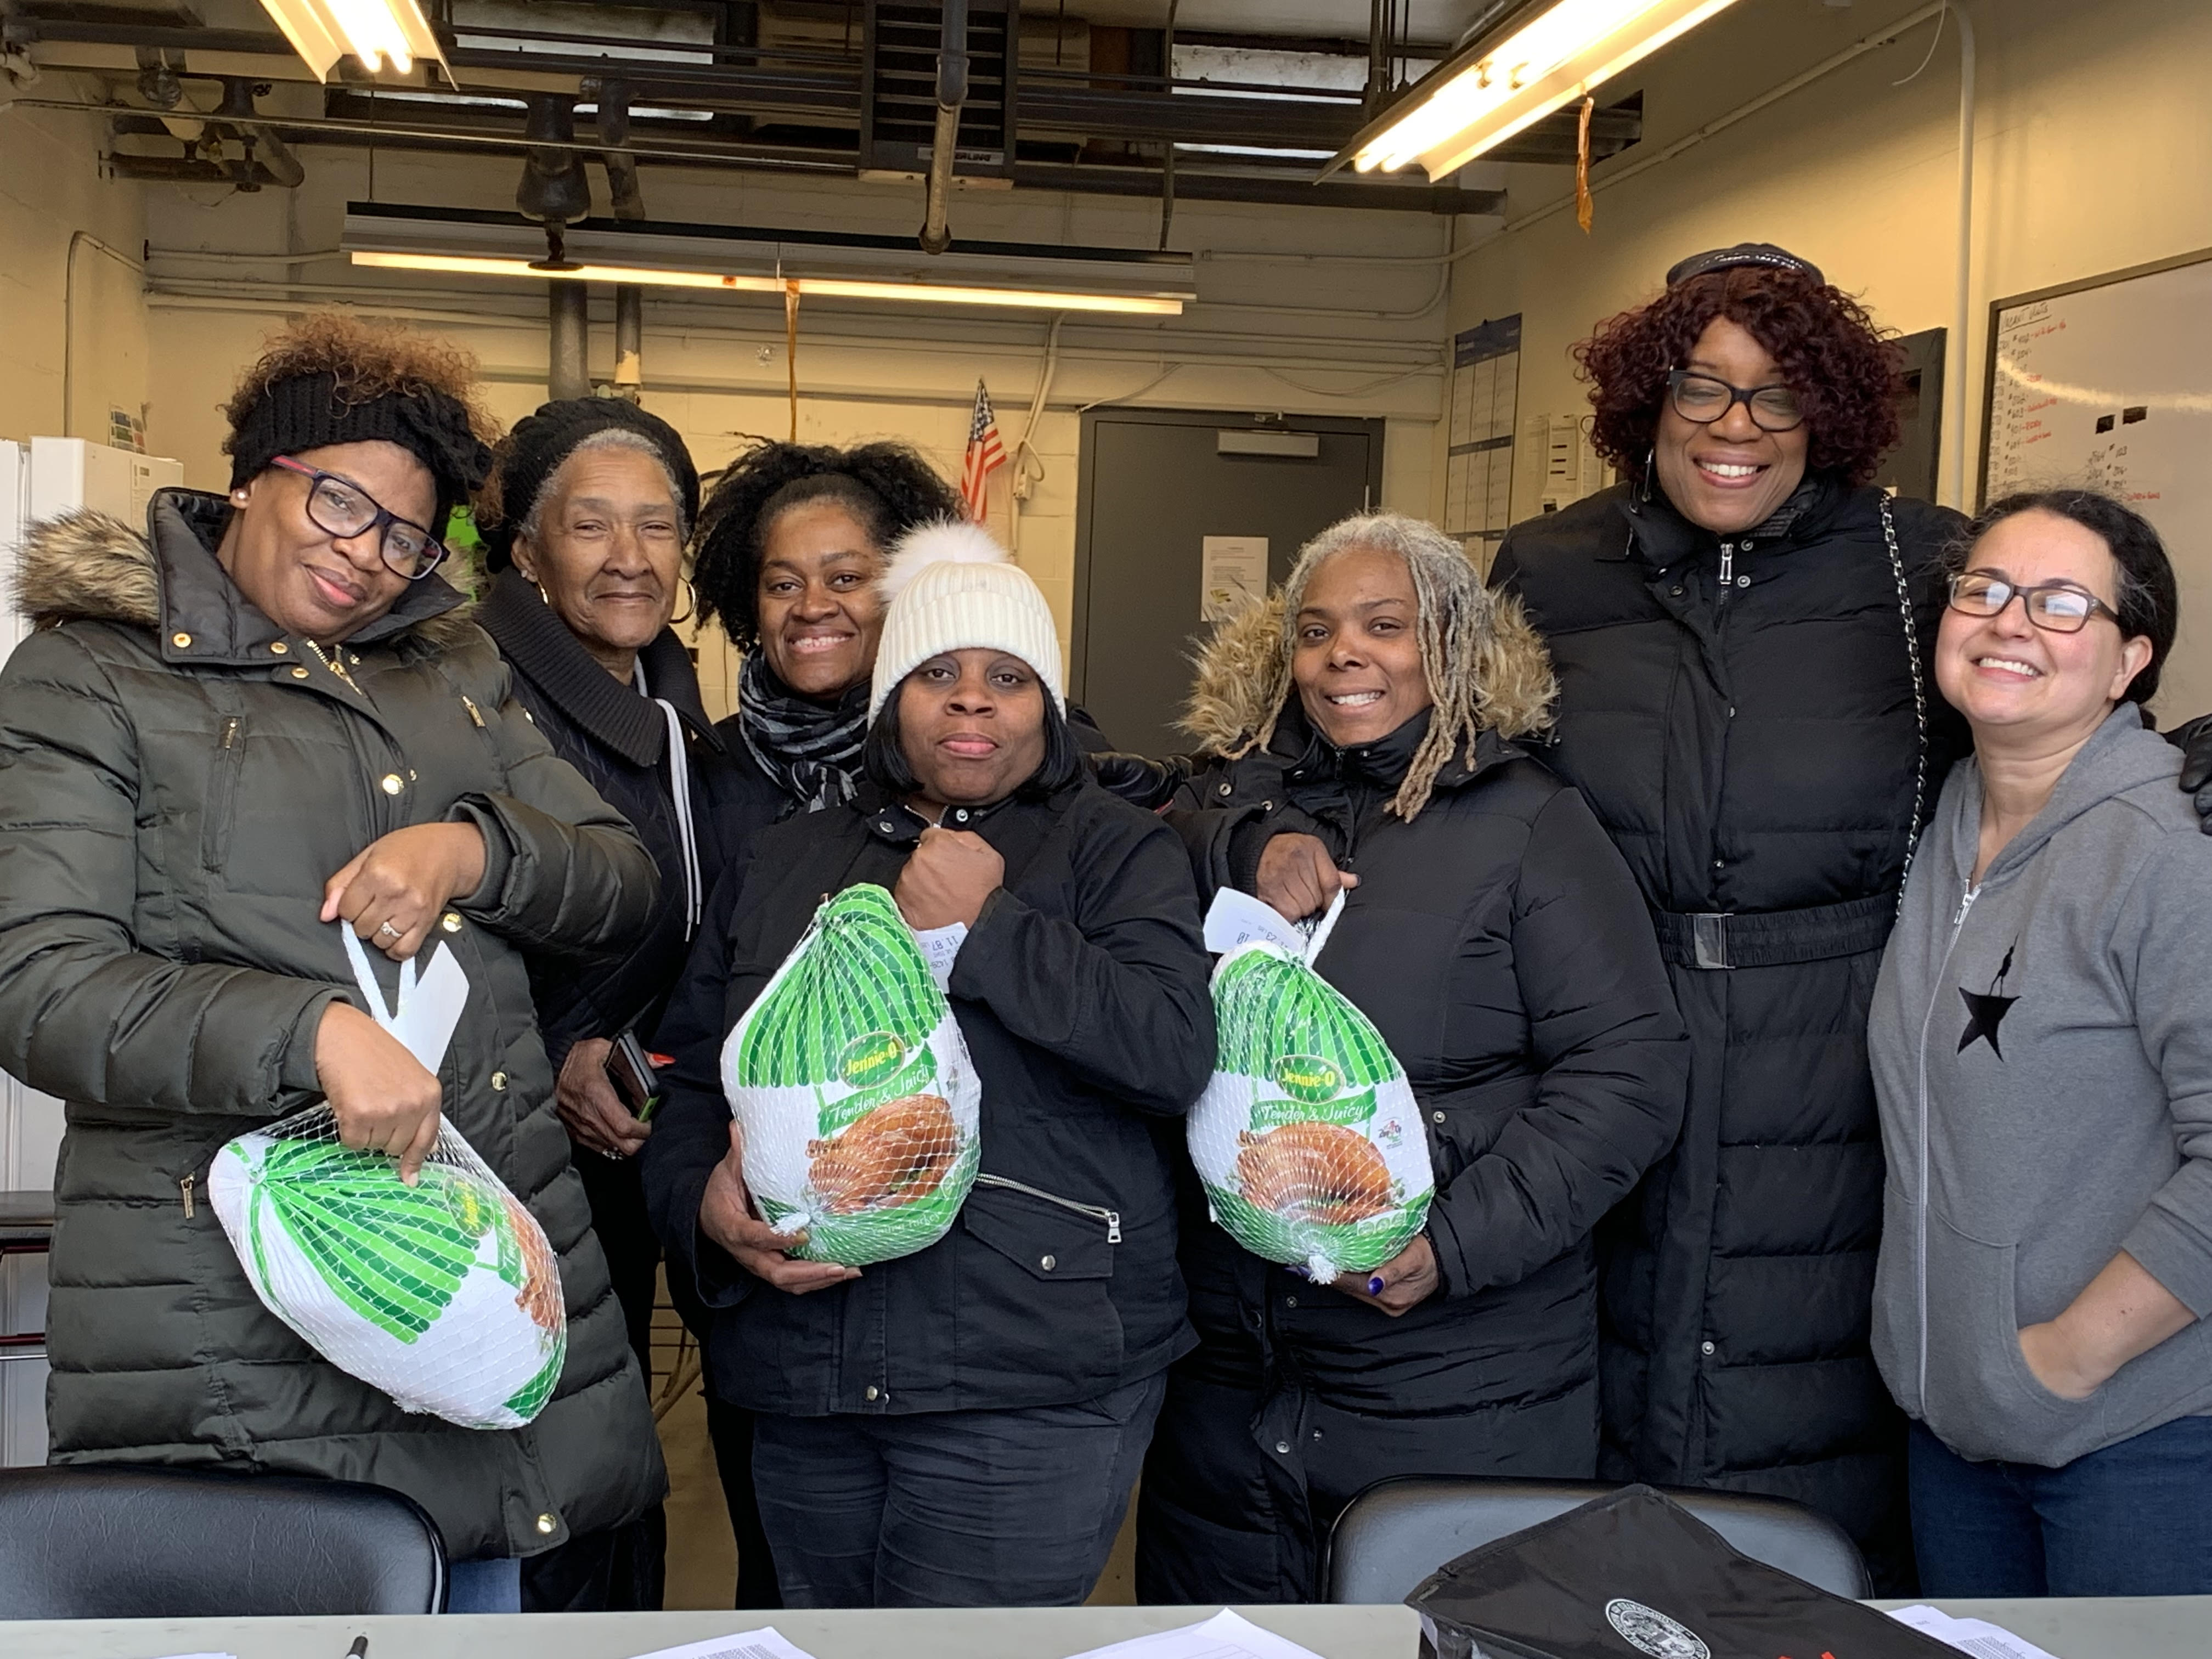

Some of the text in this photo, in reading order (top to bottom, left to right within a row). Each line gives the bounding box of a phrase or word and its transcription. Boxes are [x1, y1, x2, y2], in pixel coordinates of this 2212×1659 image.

[846, 1042, 898, 1076] Jennie-O
[1282, 1069, 1335, 1087] Jennie-O
[828, 1097, 876, 1122] Tender
[878, 1088, 891, 1103] &
[894, 1066, 929, 1096] Juicy
[1262, 1104, 1364, 1121] Tender & Juicy
